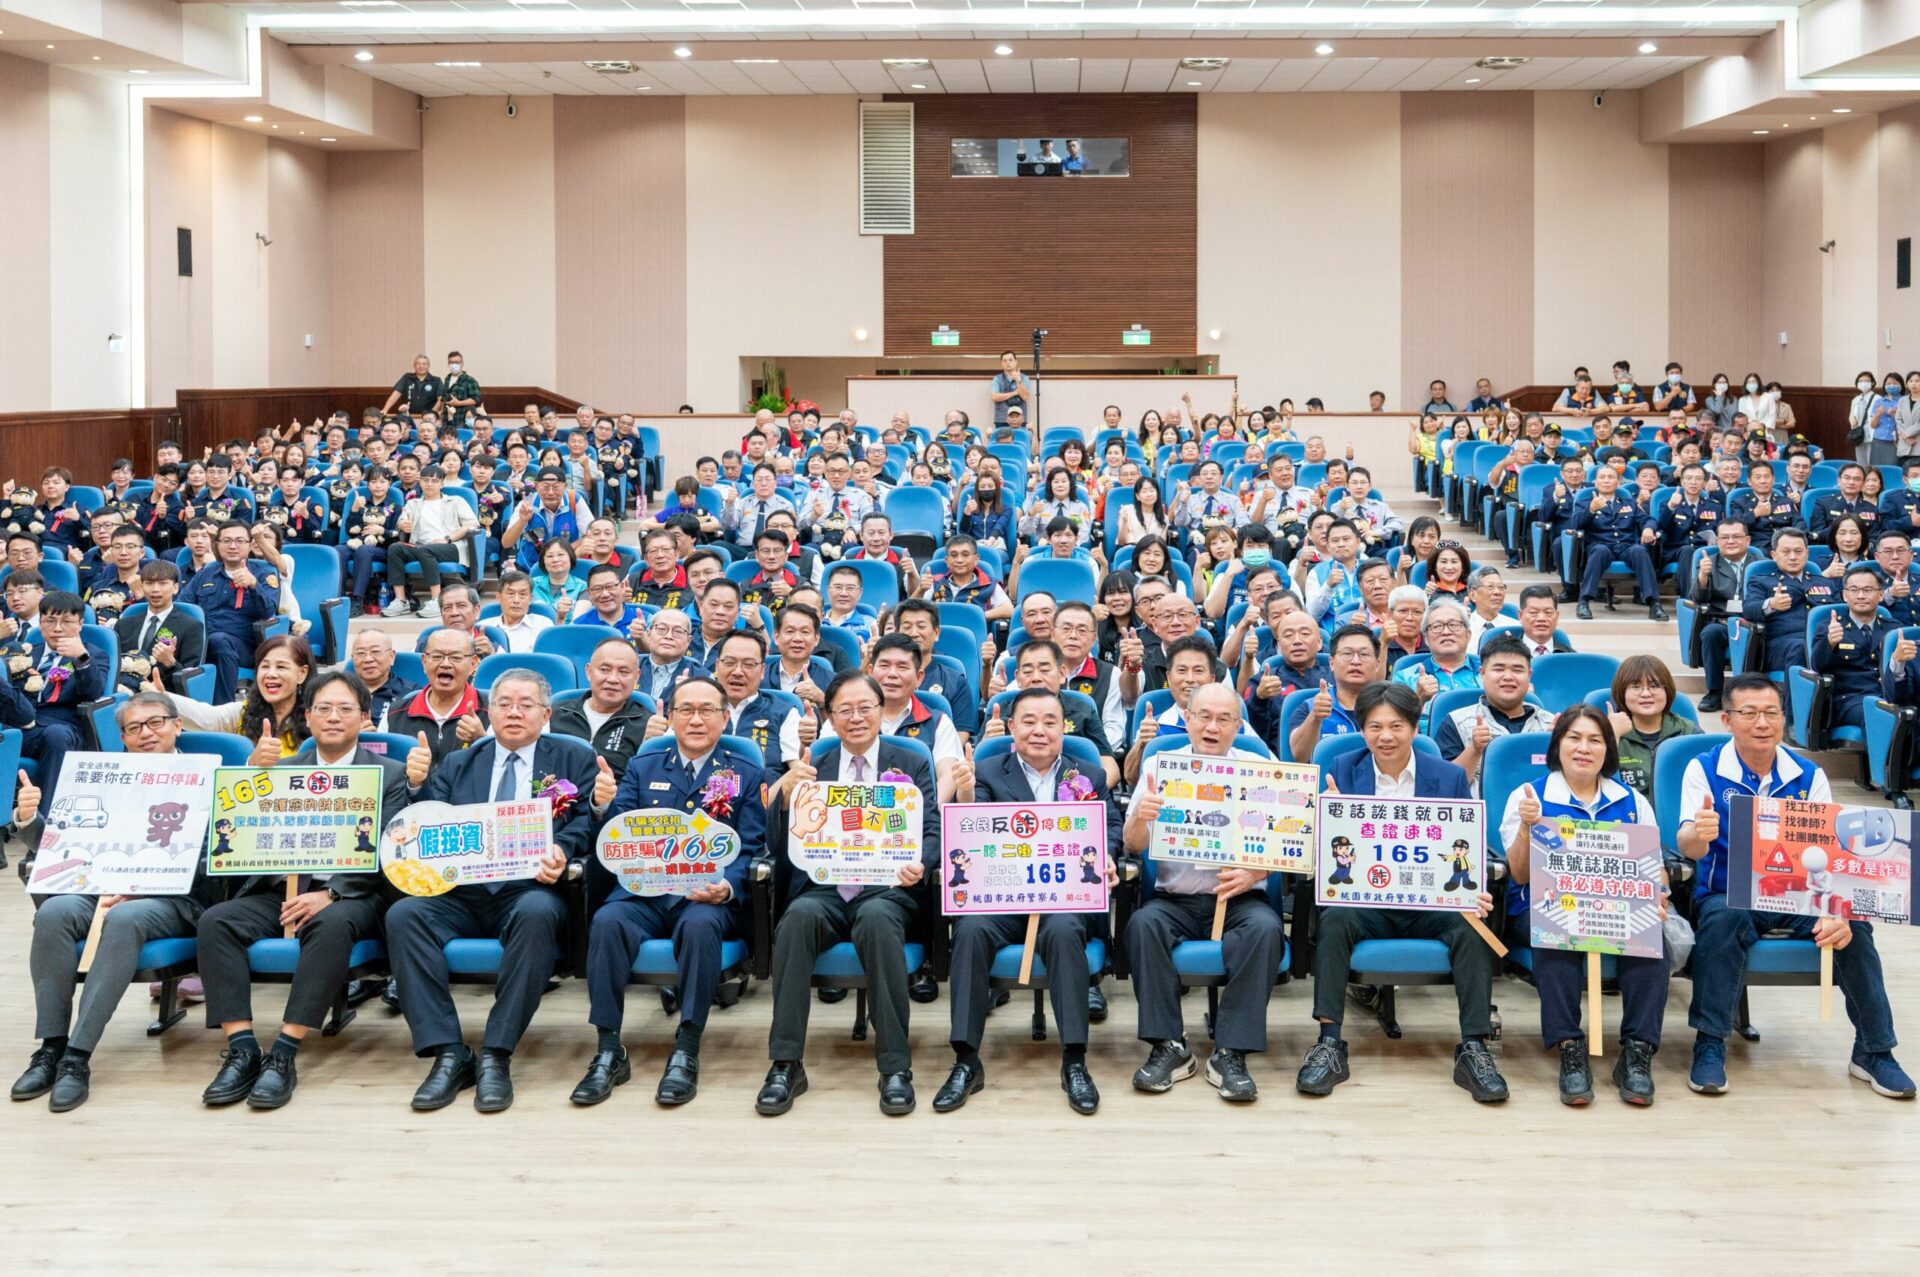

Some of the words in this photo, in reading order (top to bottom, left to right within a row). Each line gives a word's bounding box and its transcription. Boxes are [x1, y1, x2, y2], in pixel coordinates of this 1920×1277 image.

[77, 761, 120, 770] 安全過馬路
[1159, 760, 1188, 771] 反詐騙
[1205, 764, 1235, 775] 八部曲
[74, 770, 206, 787] 需要你在「路口停讓」
[217, 772, 274, 812] 165
[827, 785, 896, 808] 反詐騙
[259, 797, 377, 812] 守護您的財產安全
[1328, 802, 1475, 823] 電話談錢就可疑
[1785, 800, 1826, 814] 找工作?
[843, 811, 902, 828] 三不曲
[1785, 815, 1826, 829] 找律師?
[418, 823, 483, 858] 假投資
[1360, 823, 1443, 841] 查證速撥
[1785, 831, 1836, 845] 社團購物?
[604, 841, 657, 860] 防詐騙
[661, 834, 732, 861] 165
[1244, 843, 1264, 854] 110
[1283, 846, 1302, 857] 165
[1373, 844, 1429, 864] 165
[1576, 840, 1625, 851] 讓行人優先通行
[1169, 848, 1236, 862] 桃園市政府警察局
[1548, 853, 1637, 876] 無號誌路口
[1832, 858, 1910, 880] 多數是詐騙
[1026, 863, 1066, 884] 165
[1558, 876, 1653, 897] 務必遵守停讓
[972, 893, 1058, 904] 桃園市政府警察局
[1341, 891, 1428, 904] 桃園市政府警察局
